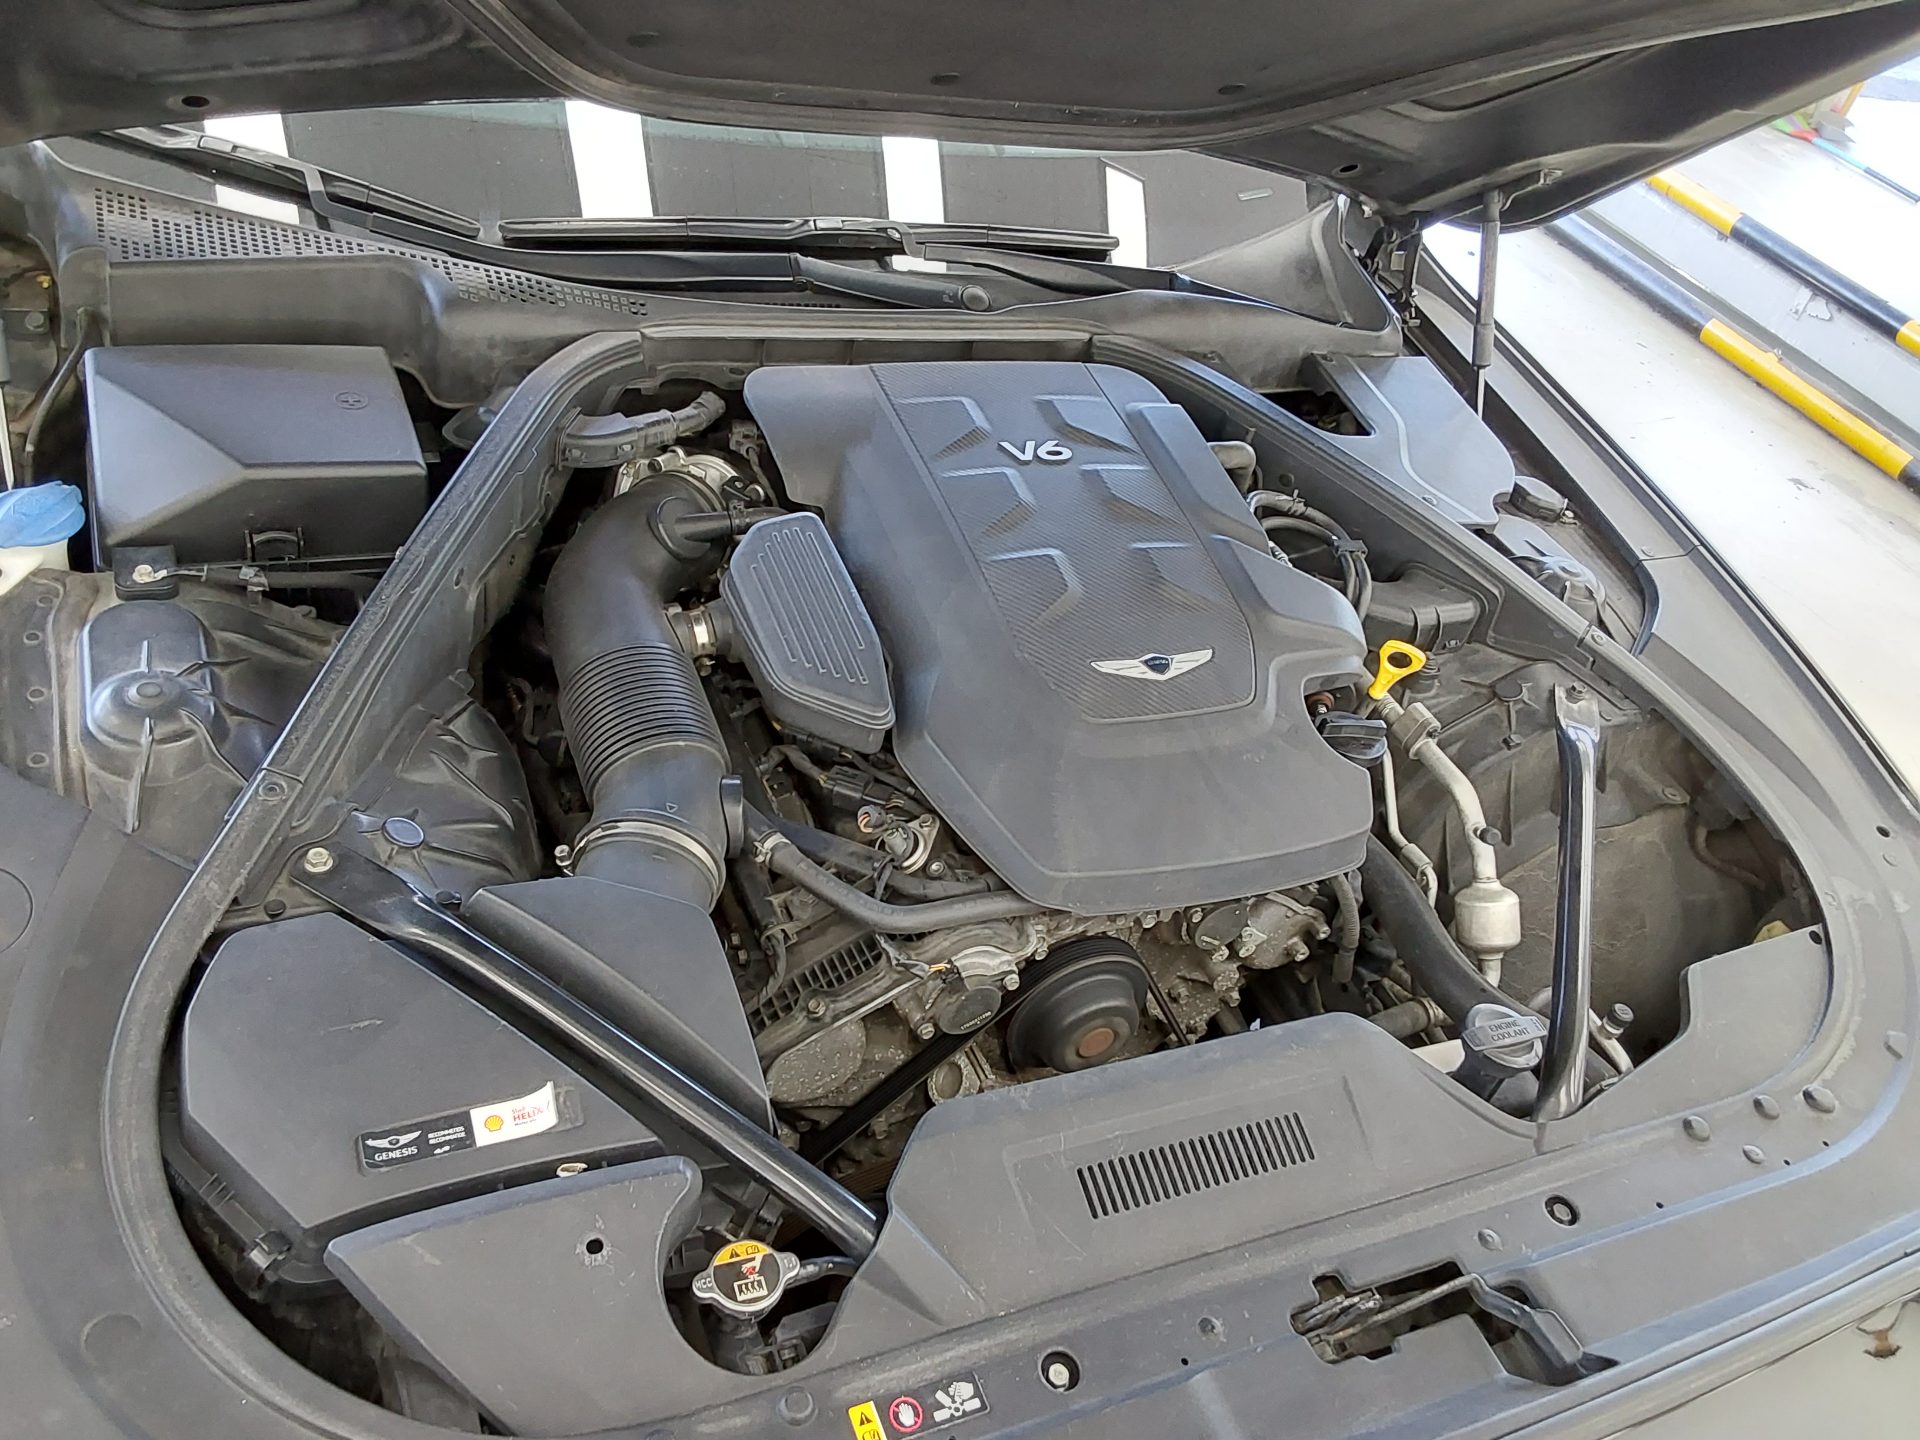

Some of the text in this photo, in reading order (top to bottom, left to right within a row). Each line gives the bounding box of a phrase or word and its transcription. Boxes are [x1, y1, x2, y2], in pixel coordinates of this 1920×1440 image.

[998, 440, 1073, 461] V6
[1488, 1019, 1521, 1032] ENGINE
[1491, 1027, 1531, 1042] COOLANT
[513, 1107, 544, 1122] HELIX
[375, 1146, 418, 1161] GENESIS
